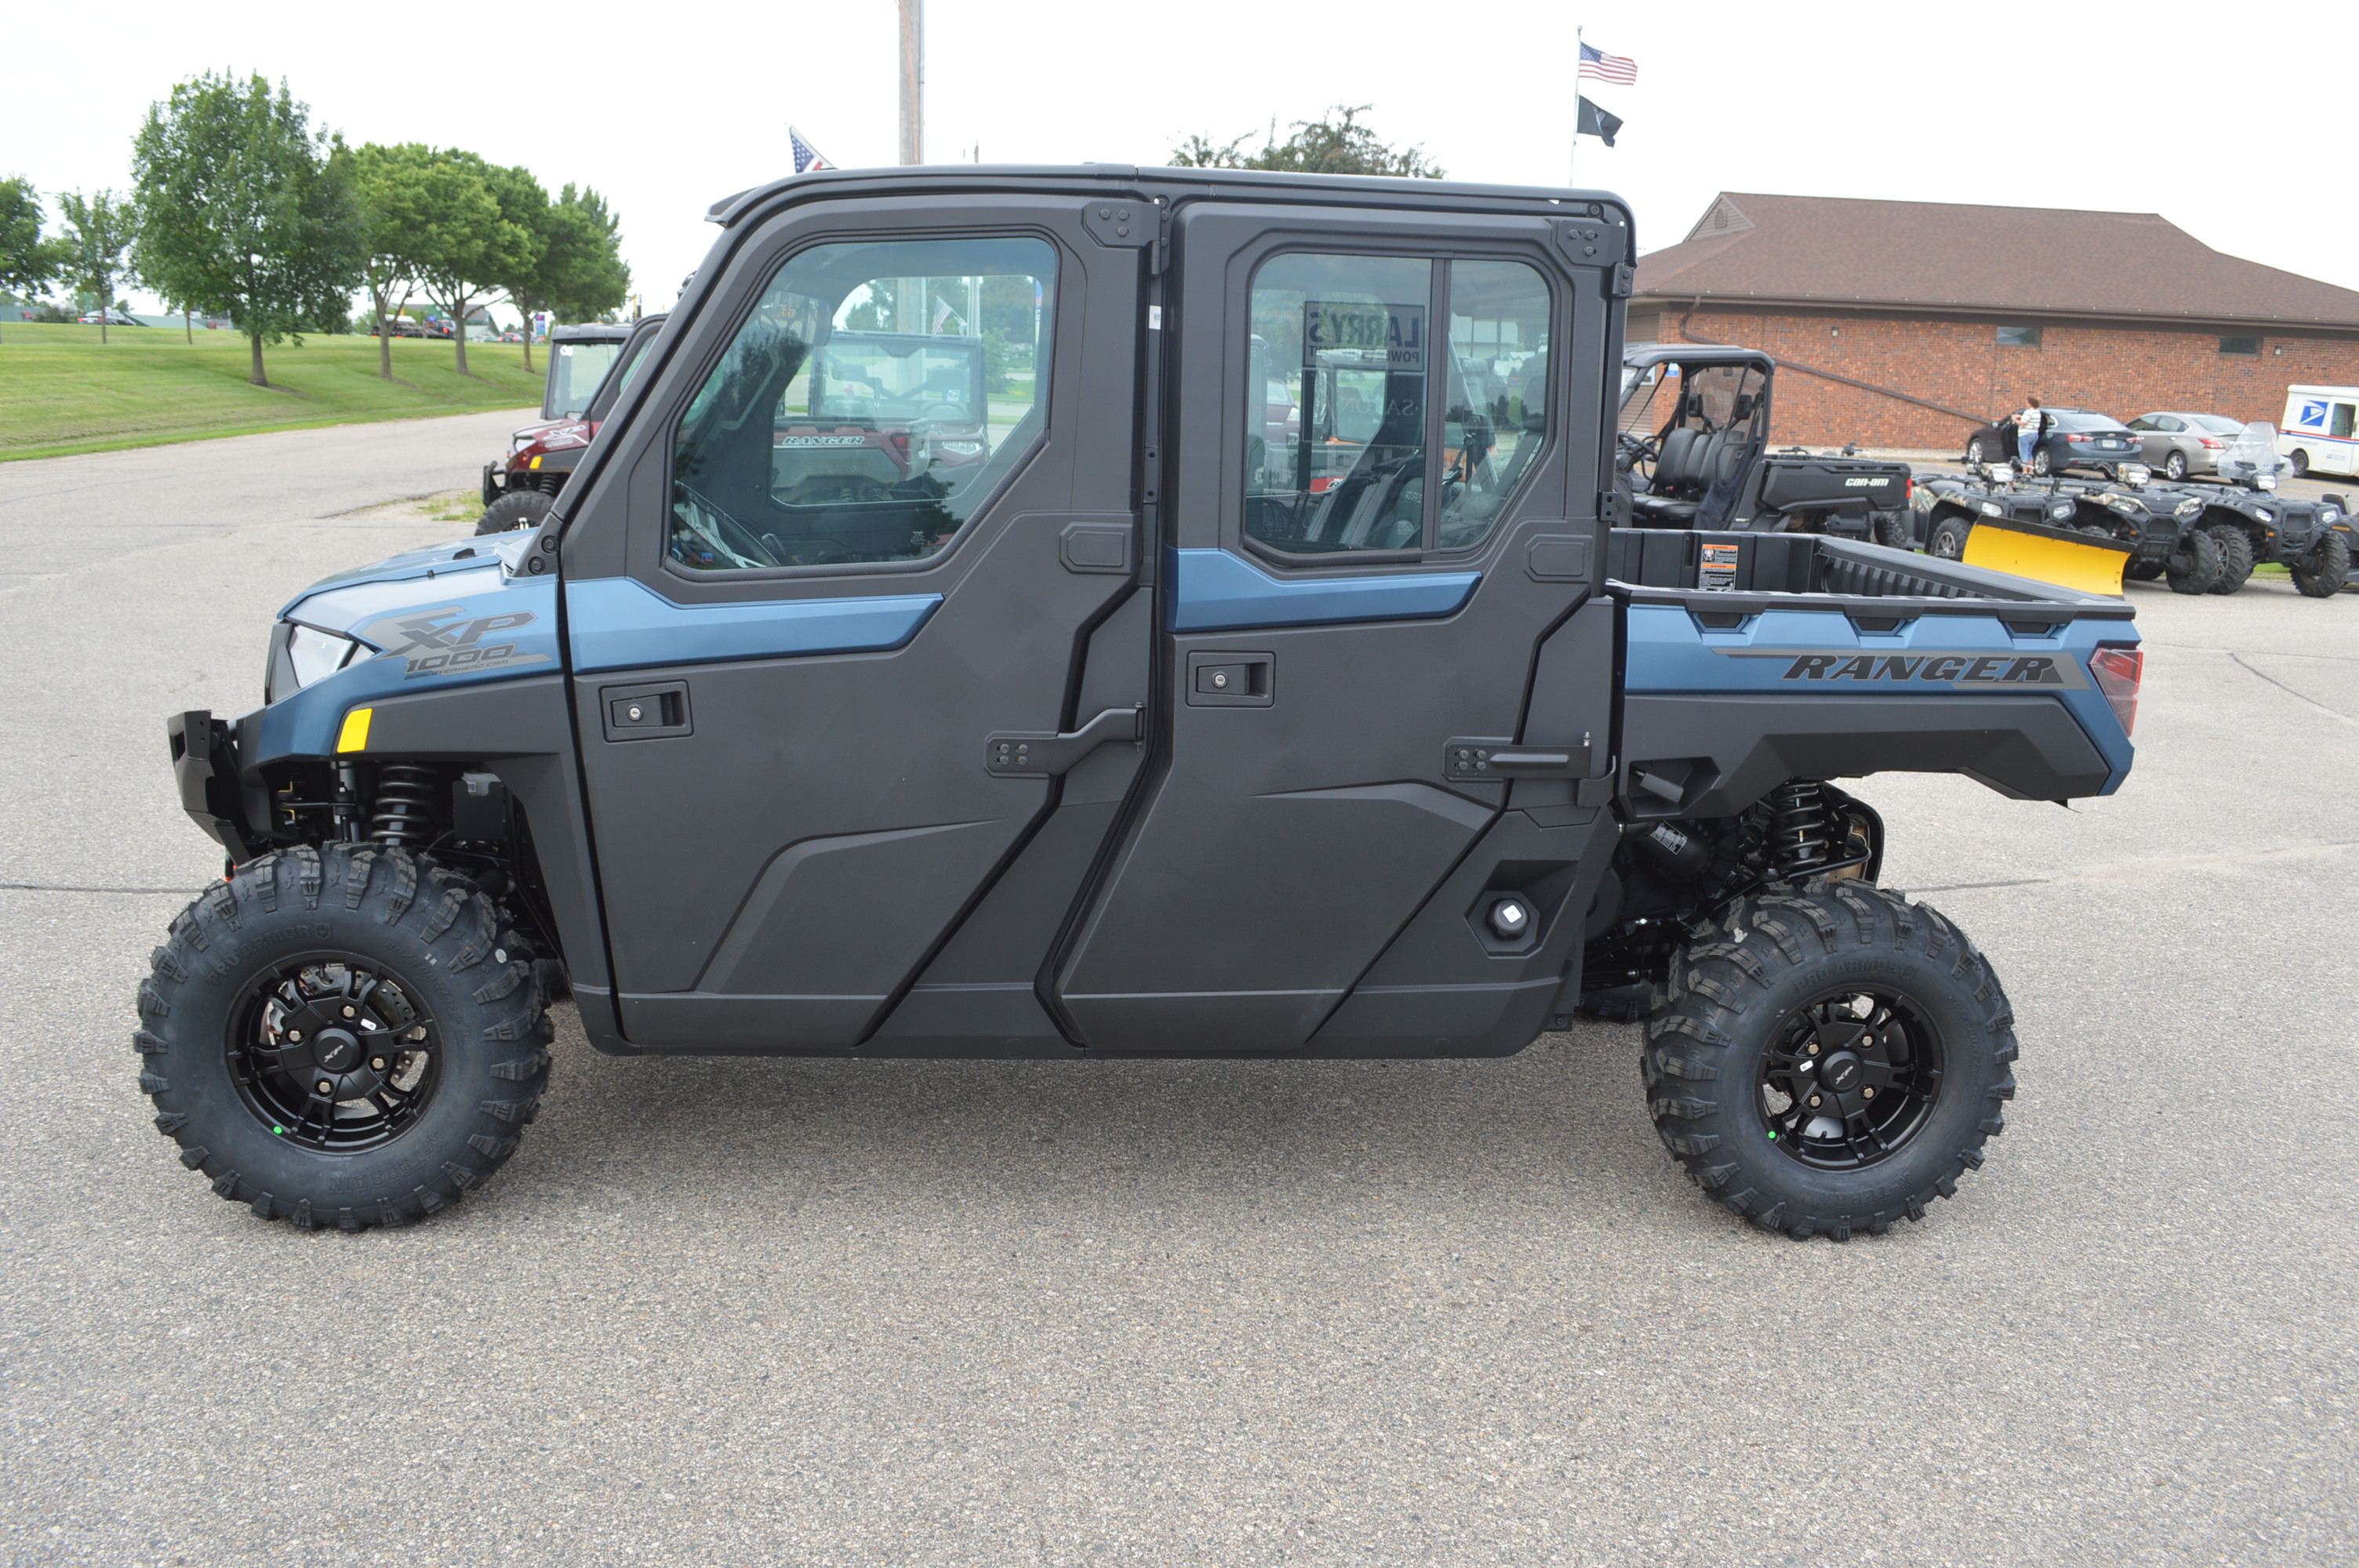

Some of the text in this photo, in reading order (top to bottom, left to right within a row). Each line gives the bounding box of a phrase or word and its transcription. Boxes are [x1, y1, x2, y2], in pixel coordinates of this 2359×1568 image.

[782, 436, 865, 445] RANGER
[1845, 477, 1889, 487] can-am
[382, 612, 537, 658] XP
[405, 644, 515, 673] 1000
[1781, 655, 2055, 683] RANGER
[241, 925, 312, 955] ARMOR
[1794, 959, 1899, 993] PRO ARMOR
